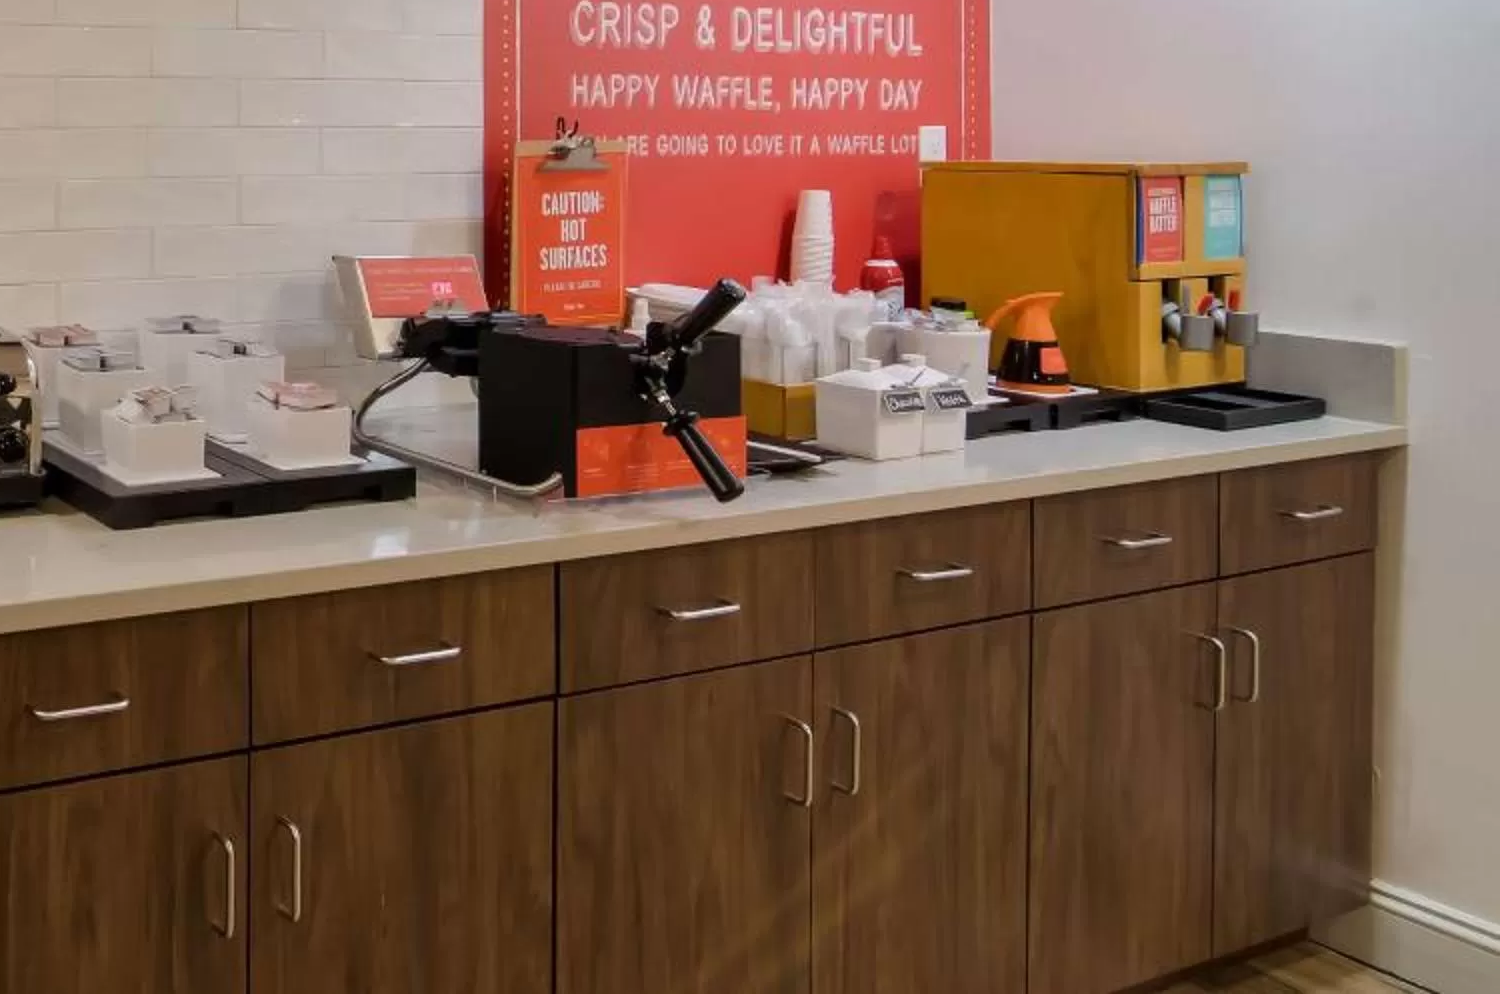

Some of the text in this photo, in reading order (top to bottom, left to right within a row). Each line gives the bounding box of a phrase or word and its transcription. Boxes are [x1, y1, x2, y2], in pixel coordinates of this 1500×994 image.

[570, 0, 924, 57] CRISP & DELIGHTFUL
[571, 73, 923, 114] HAPPY WAFFLE, HAPPY DAY
[656, 134, 709, 157] GOING
[717, 135, 737, 156] TO
[744, 135, 783, 156] LOVE
[790, 135, 804, 156] IT
[810, 135, 821, 156] A
[828, 134, 885, 156] WAFFLE
[561, 218, 587, 242] HOT
[540, 244, 607, 271] SURFACES
